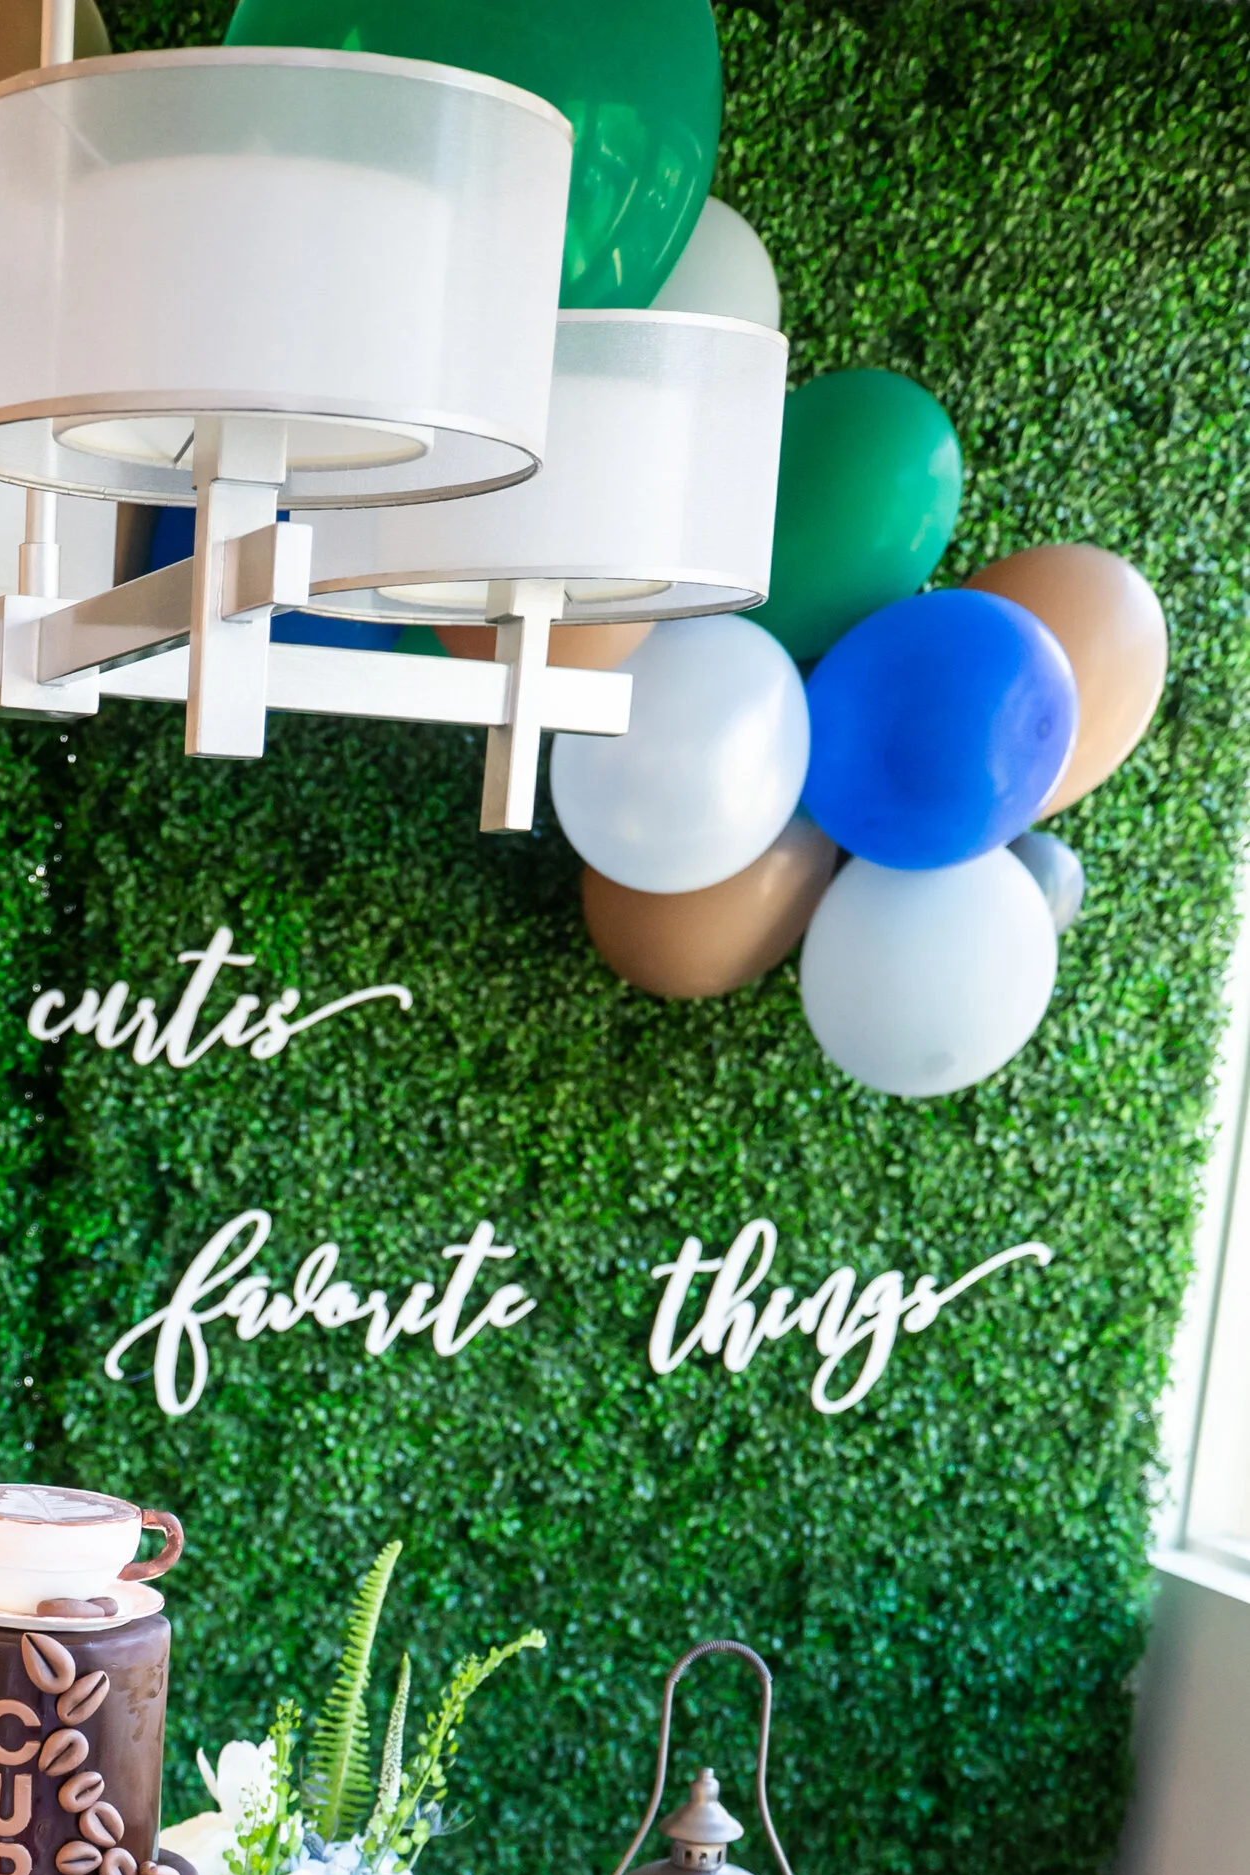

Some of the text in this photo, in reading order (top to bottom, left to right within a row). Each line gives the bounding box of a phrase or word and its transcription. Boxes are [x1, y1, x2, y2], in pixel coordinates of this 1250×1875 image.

[27, 926, 414, 1068] curtis
[104, 1209, 1053, 1415] favorite things
